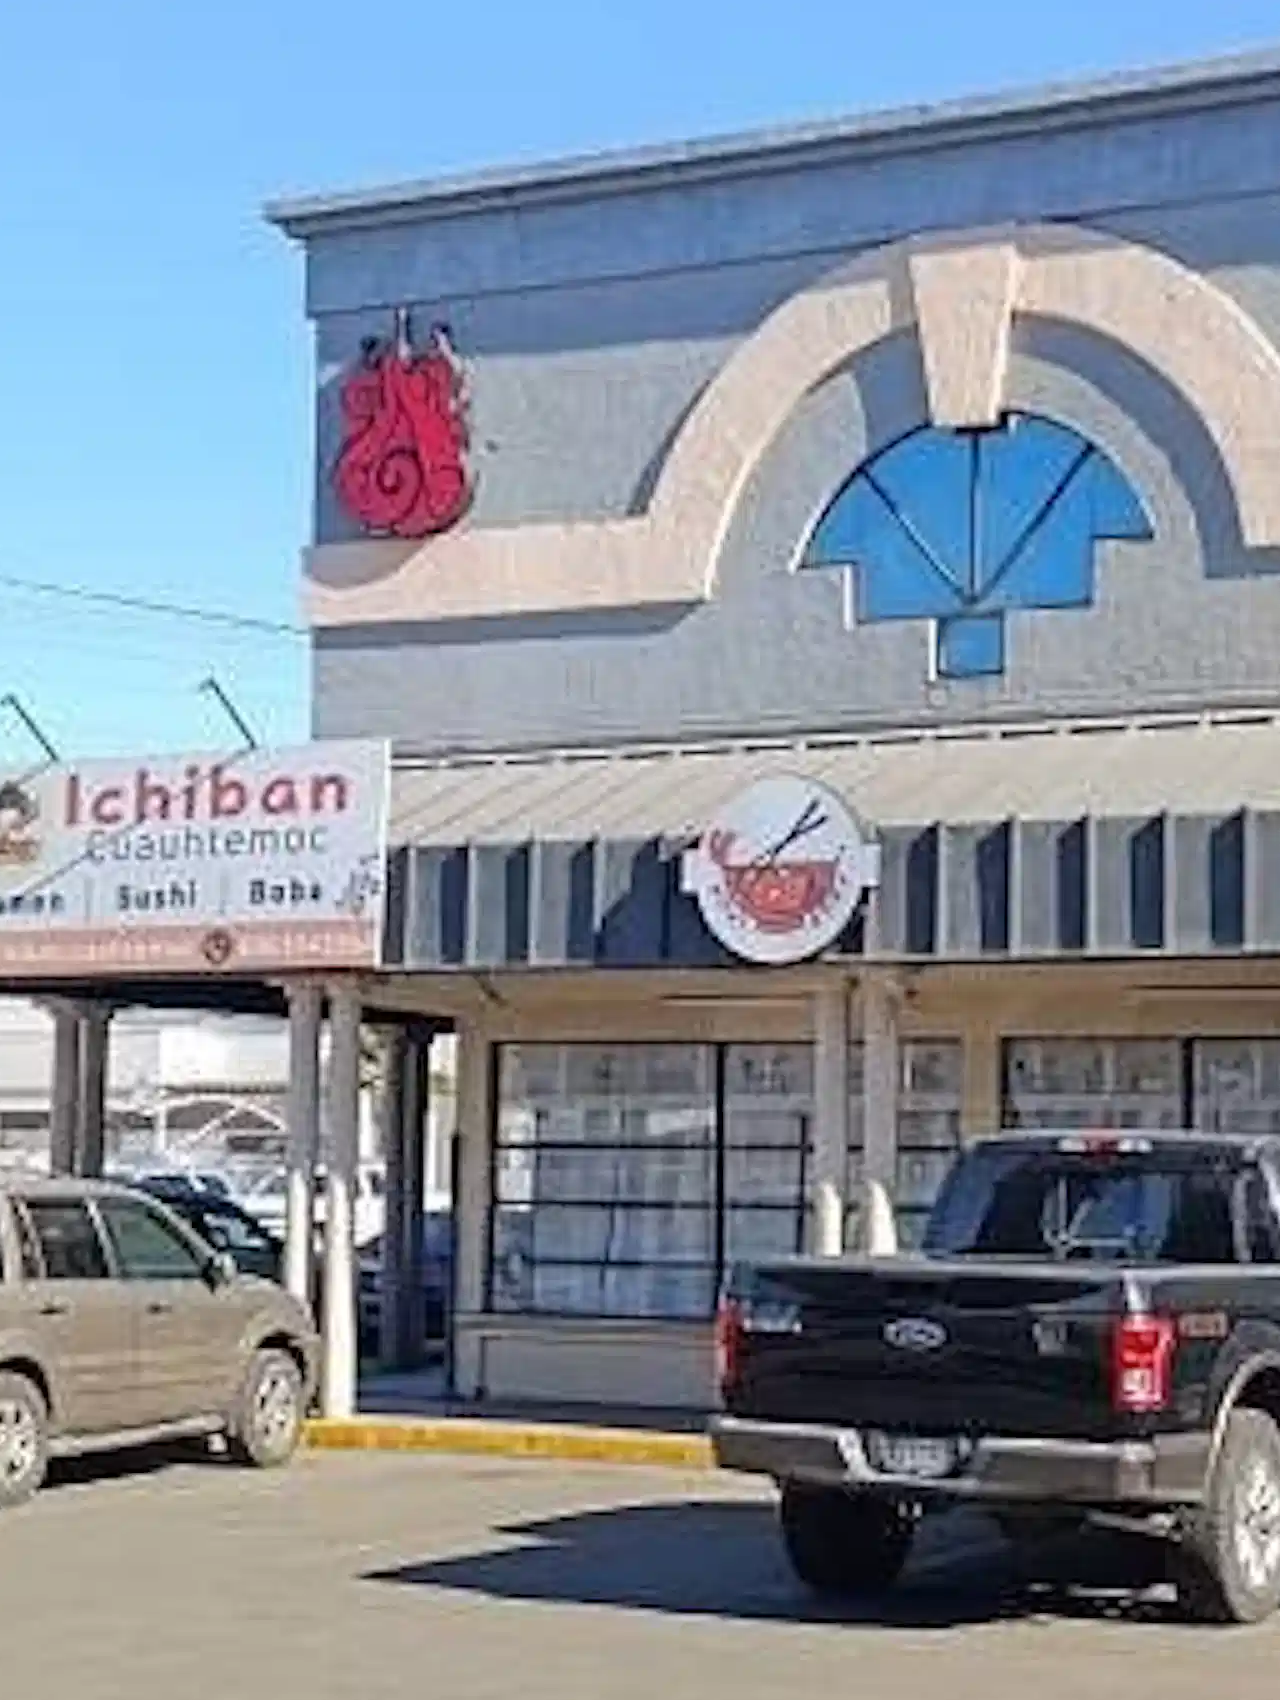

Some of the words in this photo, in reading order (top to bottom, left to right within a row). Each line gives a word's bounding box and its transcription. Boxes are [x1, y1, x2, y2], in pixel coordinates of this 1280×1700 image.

[63, 764, 348, 826] Ichiban
[85, 824, 328, 863] Cuauhtemoc
[117, 880, 196, 911] Sushi
